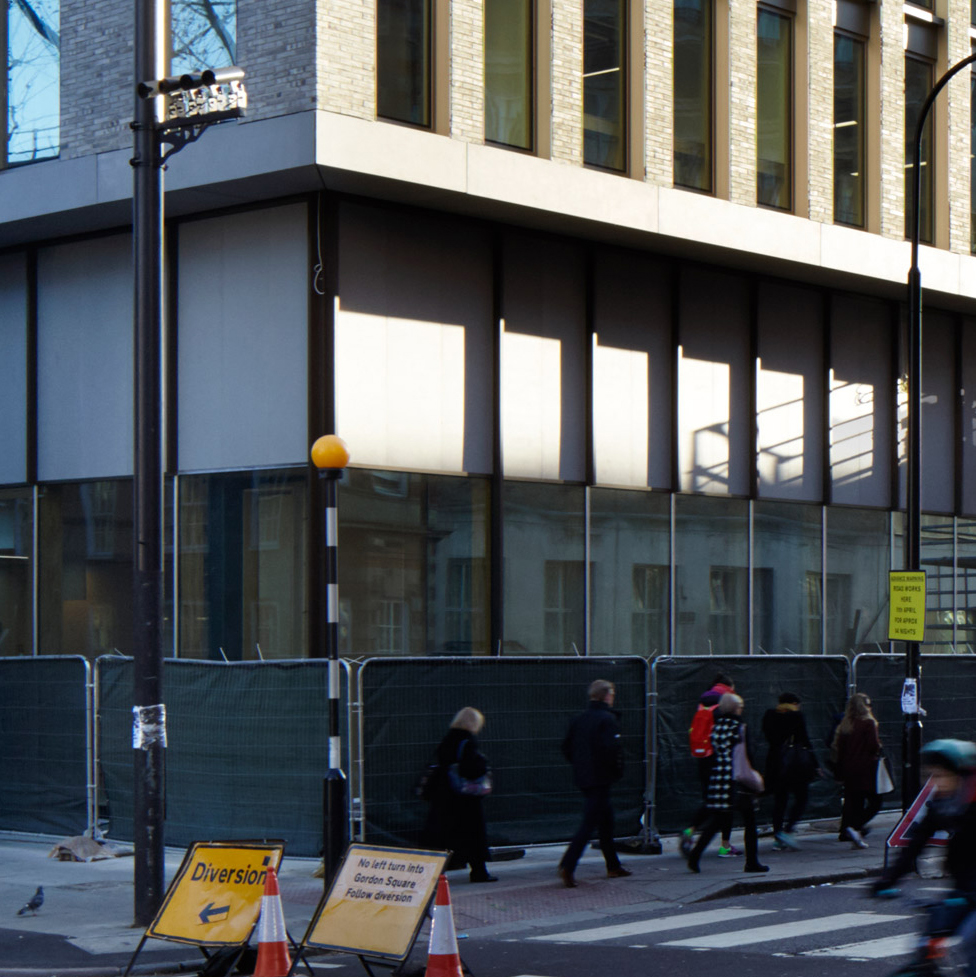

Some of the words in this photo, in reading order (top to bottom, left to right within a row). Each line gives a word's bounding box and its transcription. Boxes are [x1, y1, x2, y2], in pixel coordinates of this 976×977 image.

[190, 861, 268, 885] Diversion
[358, 858, 370, 868] No
[371, 859, 387, 870] left
[388, 861, 406, 872] turn
[407, 863, 424, 874] into
[354, 872, 384, 885] Gordon
[385, 876, 416, 889] Square
[345, 887, 373, 899] Follow
[374, 890, 413, 903] diversion
